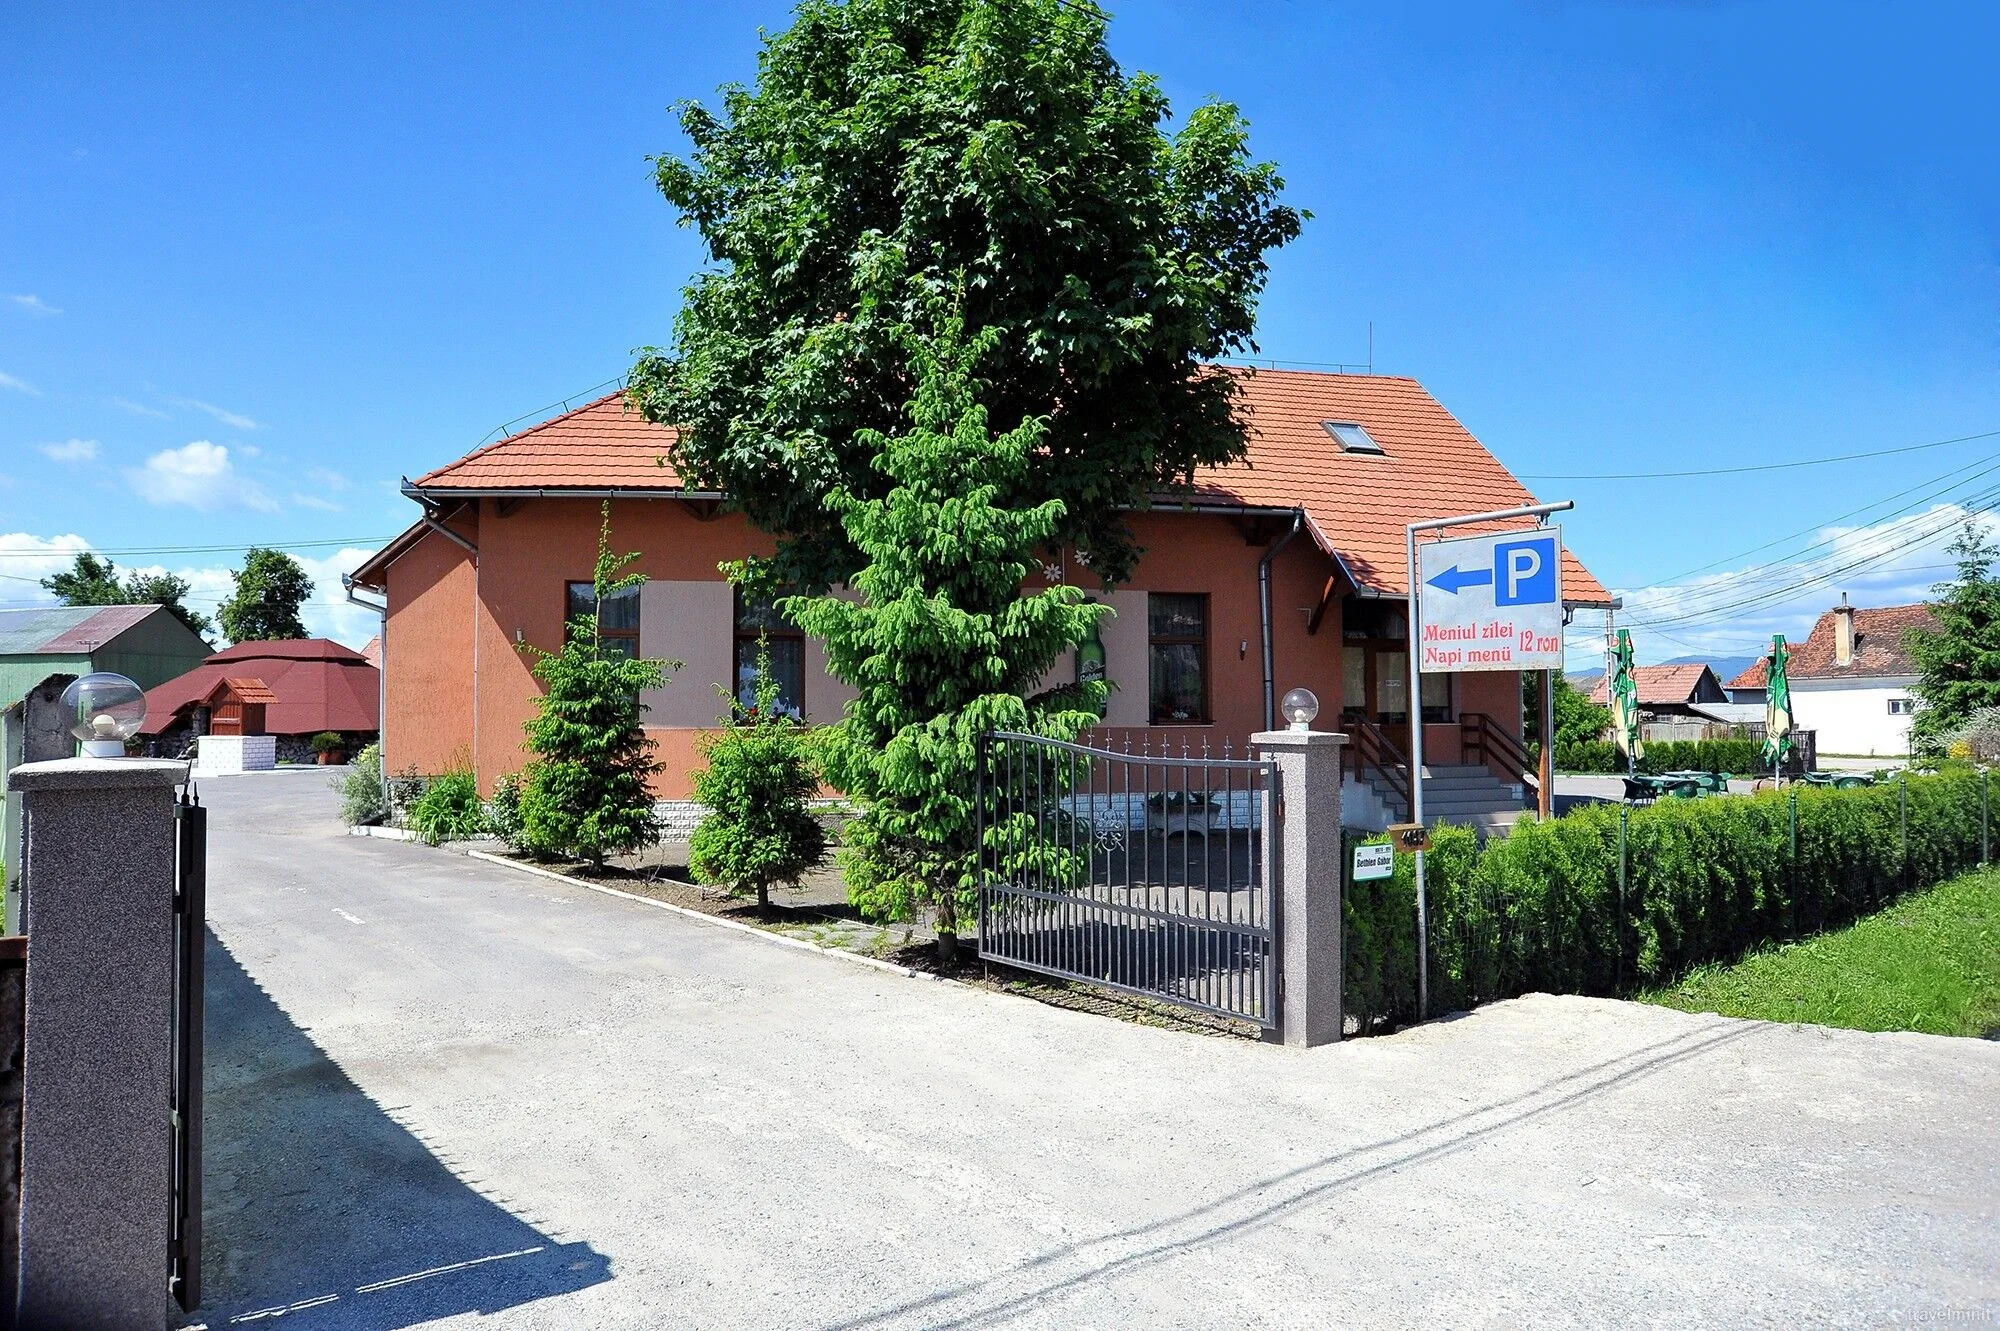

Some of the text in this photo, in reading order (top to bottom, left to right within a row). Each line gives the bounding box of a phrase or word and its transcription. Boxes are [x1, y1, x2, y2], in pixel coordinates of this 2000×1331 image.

[1508, 549, 1541, 598] P
[1424, 622, 1513, 642] Meniul zilei
[1519, 631, 1559, 652] 12 ron
[1425, 647, 1512, 666] Napi menü
